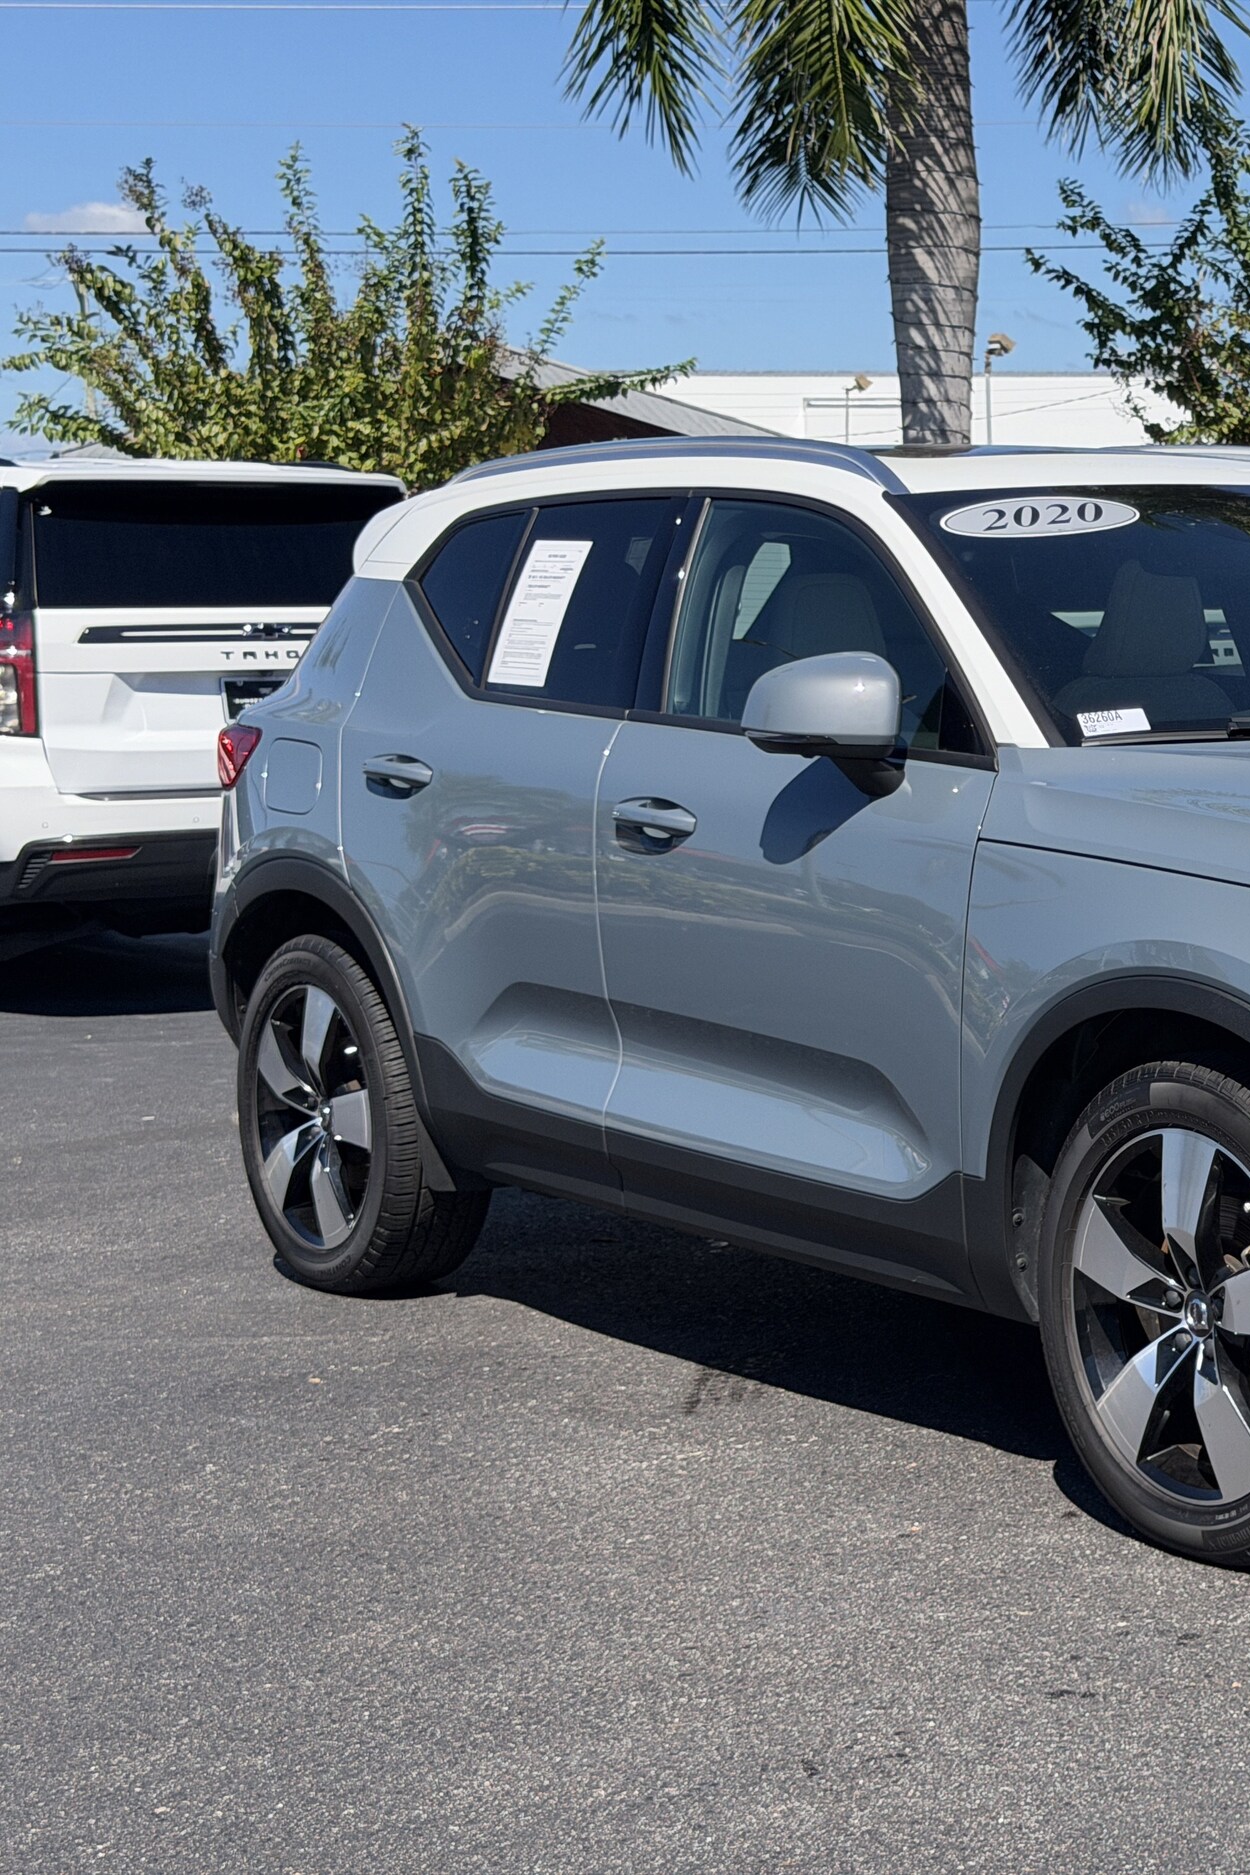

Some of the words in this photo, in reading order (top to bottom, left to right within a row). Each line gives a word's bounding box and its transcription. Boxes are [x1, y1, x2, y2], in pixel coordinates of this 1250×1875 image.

[982, 502, 1103, 532] 2020
[220, 650, 300, 660] TAHO
[1080, 711, 1123, 725] 36260A
